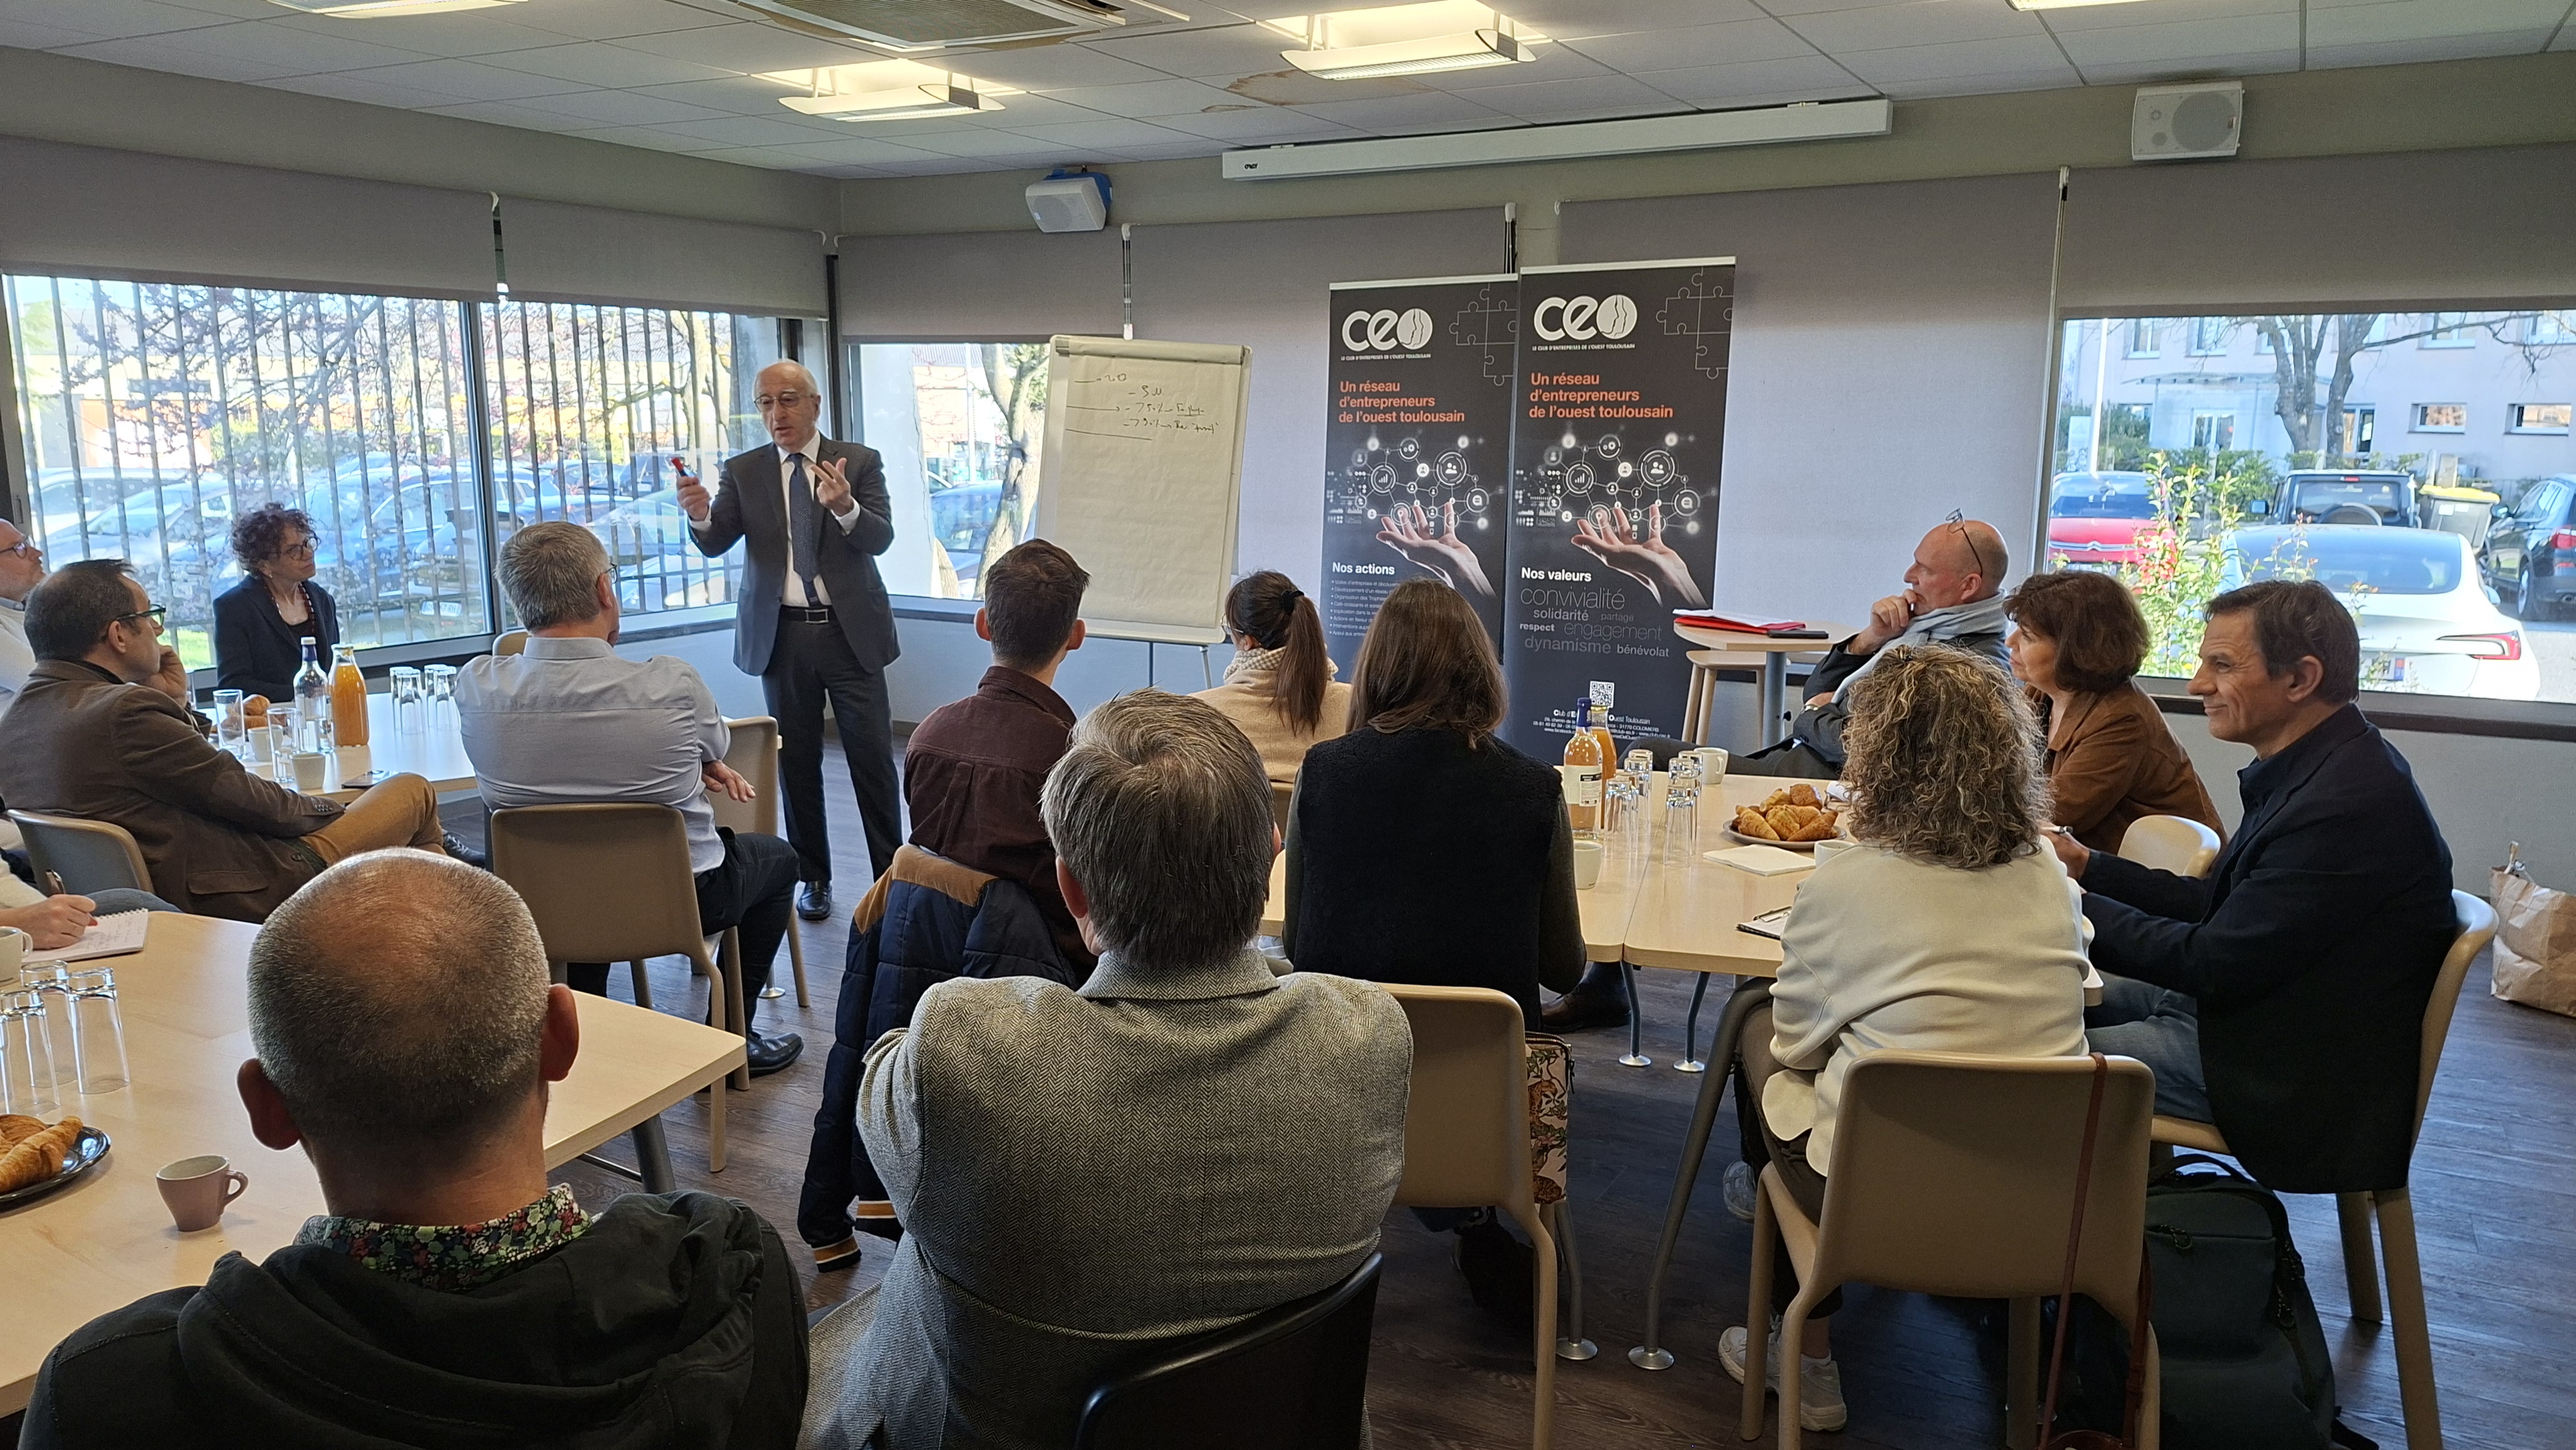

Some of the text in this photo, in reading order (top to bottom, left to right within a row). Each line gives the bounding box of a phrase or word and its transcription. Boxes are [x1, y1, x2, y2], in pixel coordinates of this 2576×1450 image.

[1531, 372, 1600, 386] Un réseau
[1340, 380, 1400, 392] Un réseau
[1340, 395, 1435, 410] d'entrepreneurs
[1530, 388, 1640, 405] d'entrepreneurs
[1339, 410, 1464, 422] de l'ouest toulousain
[1530, 405, 1673, 418] de l'ouest toulousain
[1332, 562, 1395, 575] Nos actions
[1521, 567, 1591, 582] Nos valeurs
[1520, 586, 1625, 610] convivialité
[1533, 608, 1589, 621] solidarité
[1601, 612, 1634, 623] partage
[1520, 623, 1555, 632] respect
[1564, 622, 1662, 641] engagement
[1525, 636, 1611, 654] dynamisme
[1617, 644, 1669, 657] bénévolat
